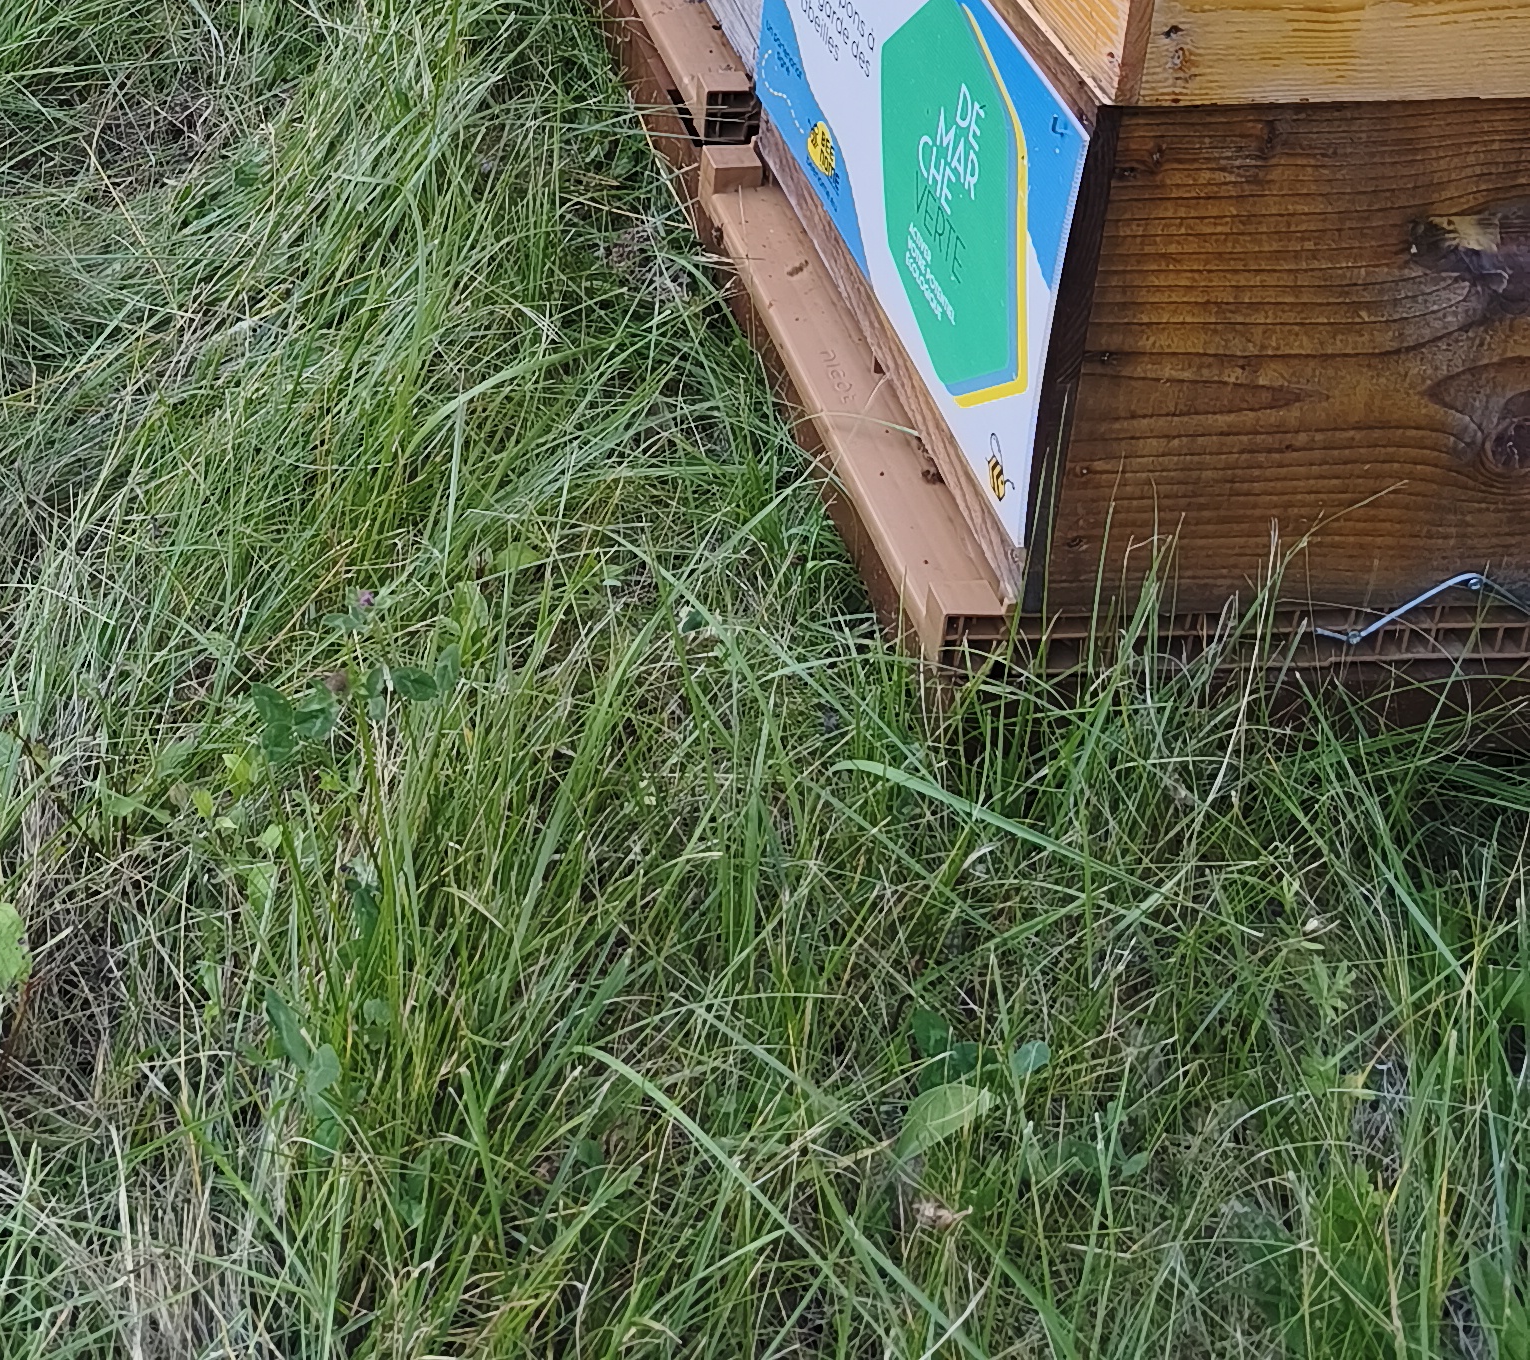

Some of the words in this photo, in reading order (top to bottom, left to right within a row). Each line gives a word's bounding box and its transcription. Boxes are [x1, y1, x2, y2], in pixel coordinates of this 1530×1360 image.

[851, 40, 871, 78] des
[867, 27, 875, 53] à
[936, 106, 979, 201] MAR
[955, 82, 986, 152] DÉ
[918, 134, 956, 216] CHE
[915, 169, 966, 285] VERTE
